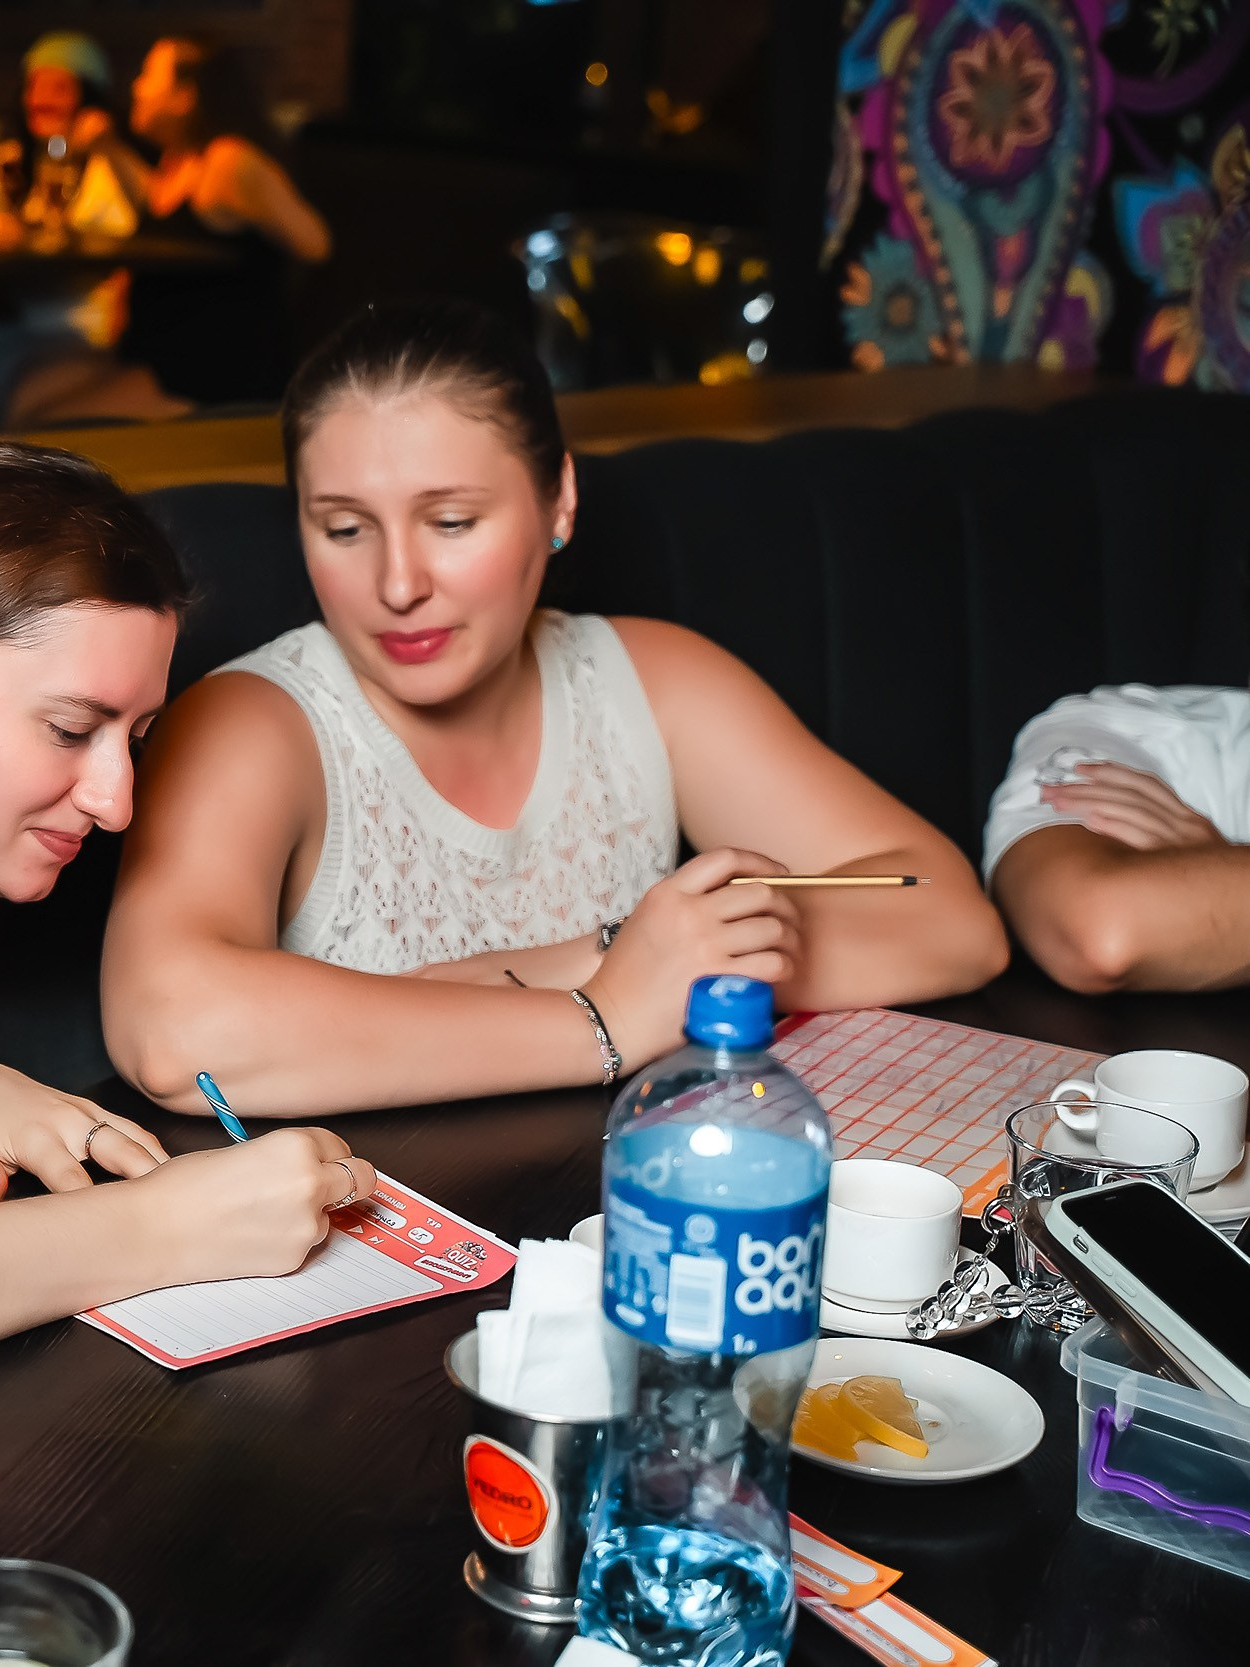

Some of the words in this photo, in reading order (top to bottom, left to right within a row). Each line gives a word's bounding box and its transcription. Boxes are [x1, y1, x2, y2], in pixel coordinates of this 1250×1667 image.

[426, 1217, 442, 1229] ТУР
[447, 1249, 478, 1269] QUIZ
[734, 1262, 821, 1316] aqu
